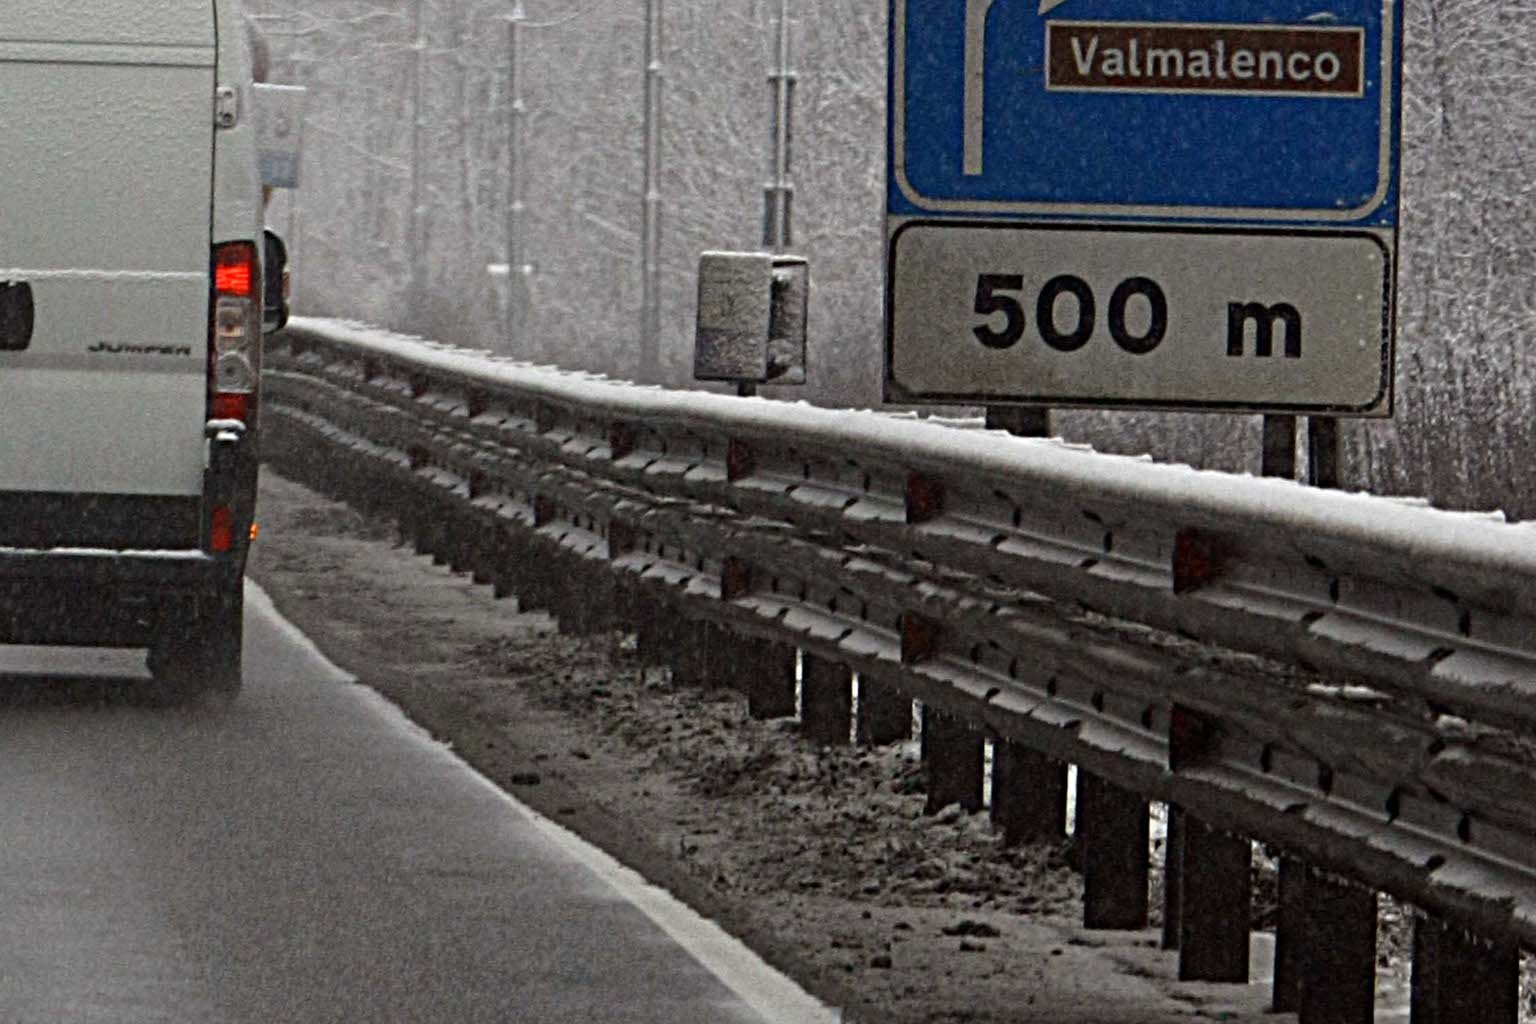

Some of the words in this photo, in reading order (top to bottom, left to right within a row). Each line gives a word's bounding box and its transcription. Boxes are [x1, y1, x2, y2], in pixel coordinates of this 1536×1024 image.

[1070, 36, 1341, 82] Valmalenco
[972, 273, 1168, 354] 500
[1226, 300, 1302, 359] m
